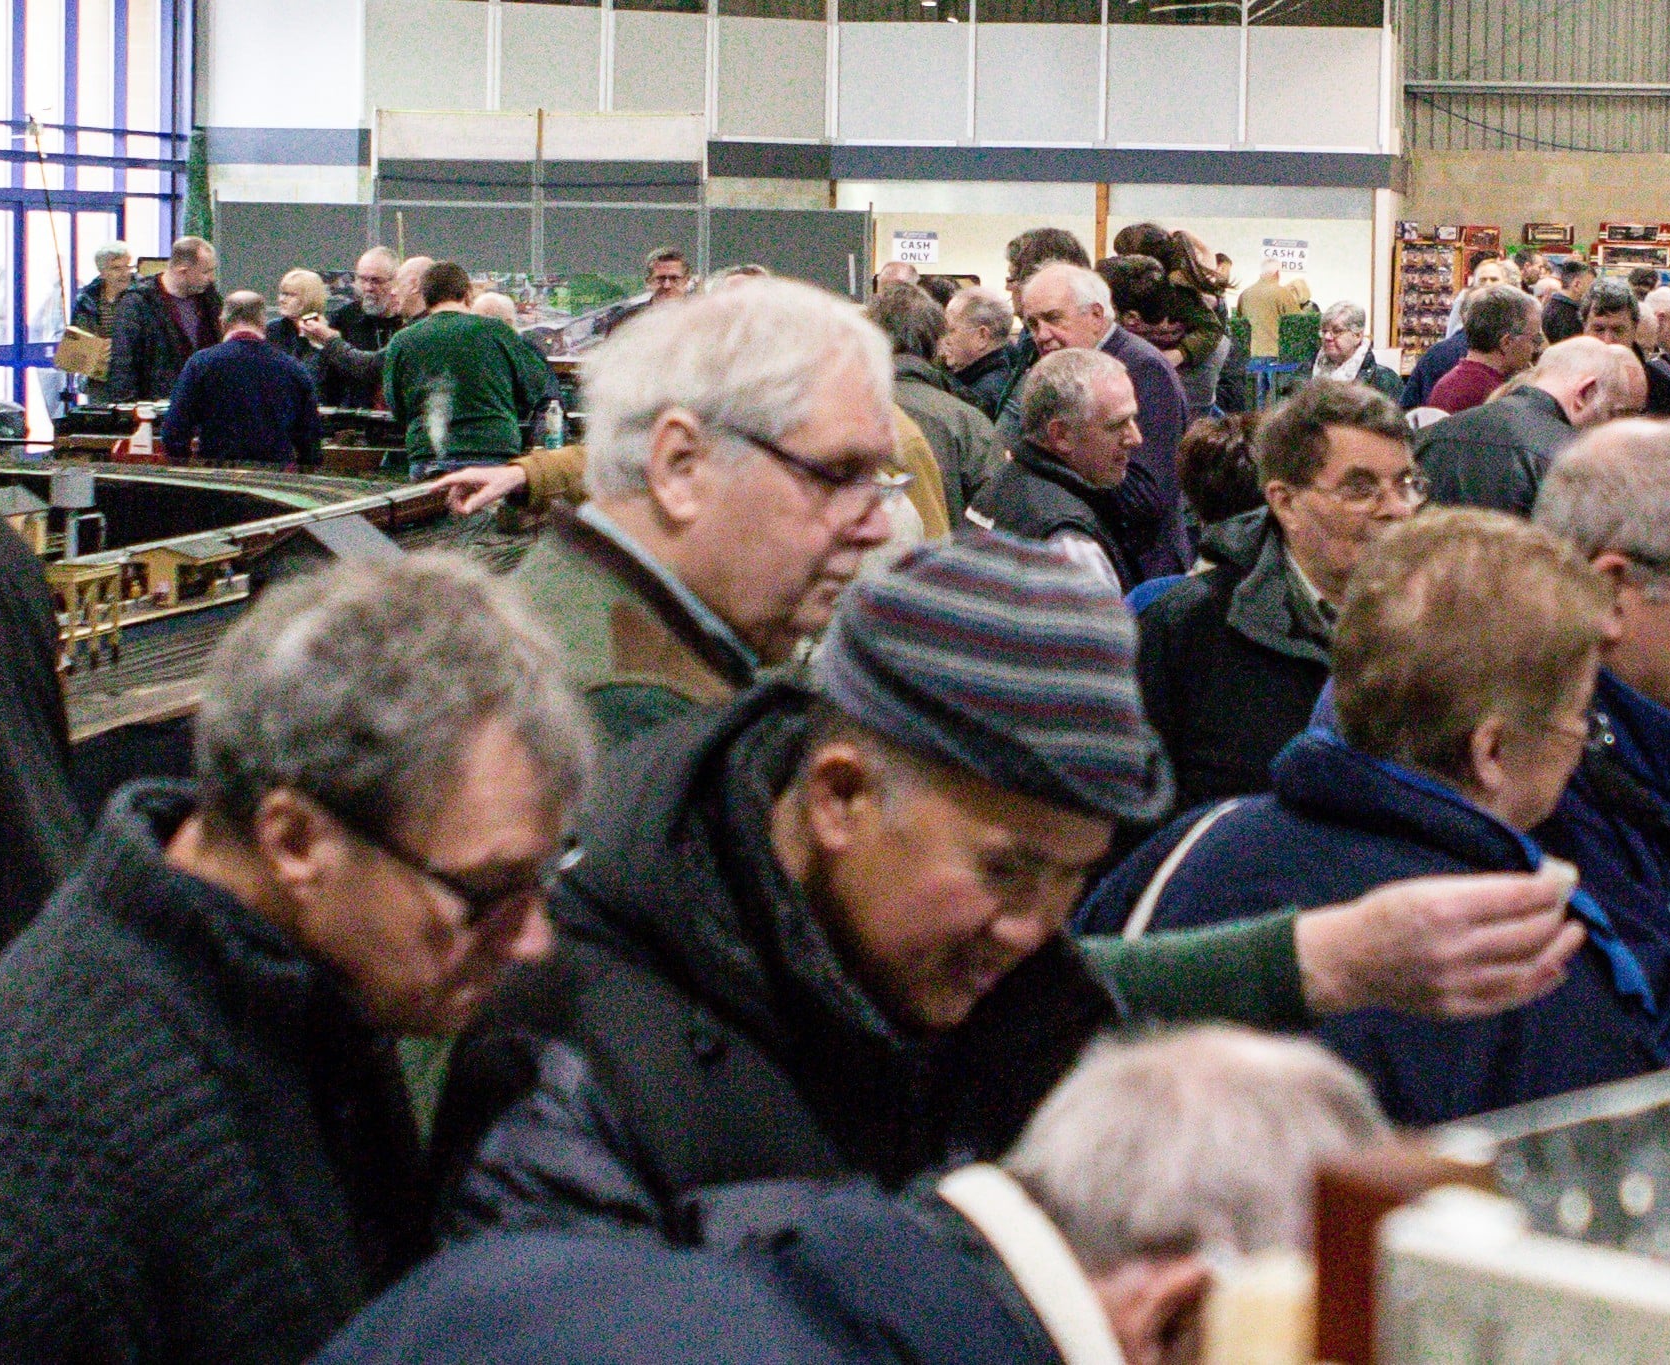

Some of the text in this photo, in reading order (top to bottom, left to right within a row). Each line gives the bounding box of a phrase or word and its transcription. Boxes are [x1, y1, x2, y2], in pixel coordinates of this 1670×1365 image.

[900, 240, 931, 250] CASH
[900, 252, 930, 262] ONLY
[1263, 248, 1306, 259] CASH &
[1281, 261, 1304, 271] RDS
